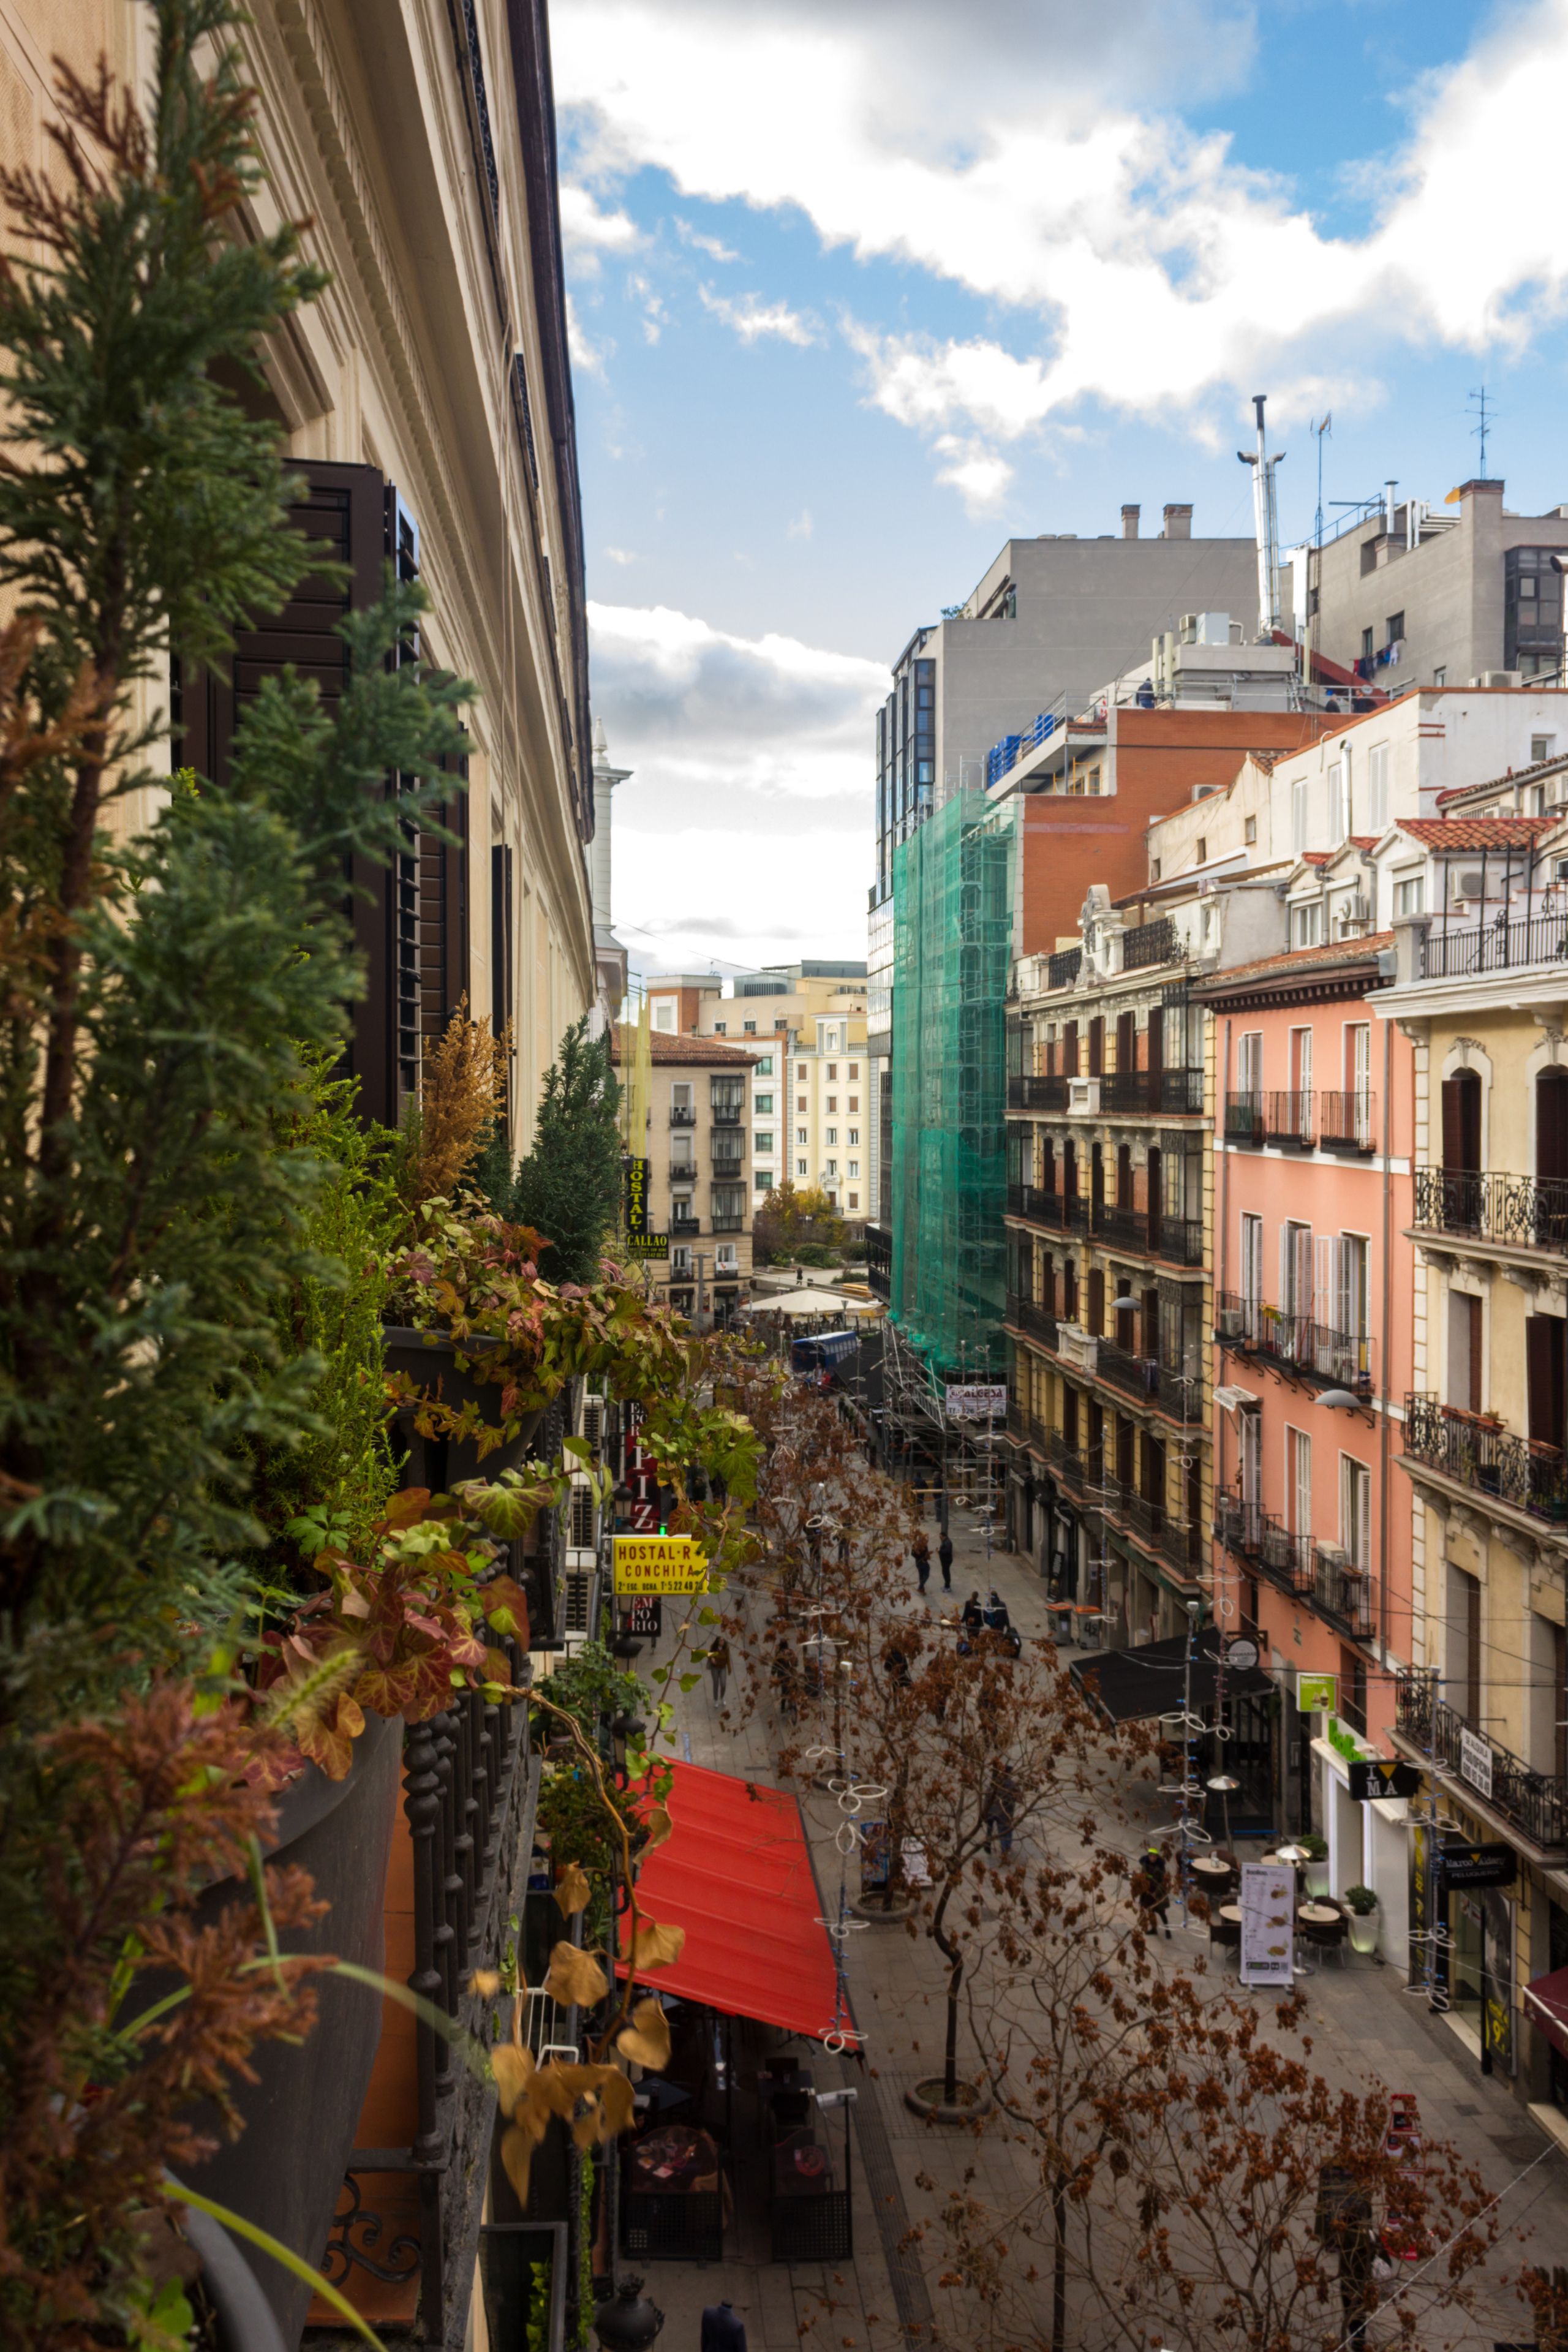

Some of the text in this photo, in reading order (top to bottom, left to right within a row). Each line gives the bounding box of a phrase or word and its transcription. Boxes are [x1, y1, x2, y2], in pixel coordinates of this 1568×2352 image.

[630, 1160, 644, 1224] HOSTAL
[627, 1235, 667, 1246] CALLAO
[625, 1565, 694, 1577] CONCHITA
[631, 1609, 650, 1620] PO
[631, 1620, 658, 1632] RIO
[1366, 1765, 1378, 1780] I
